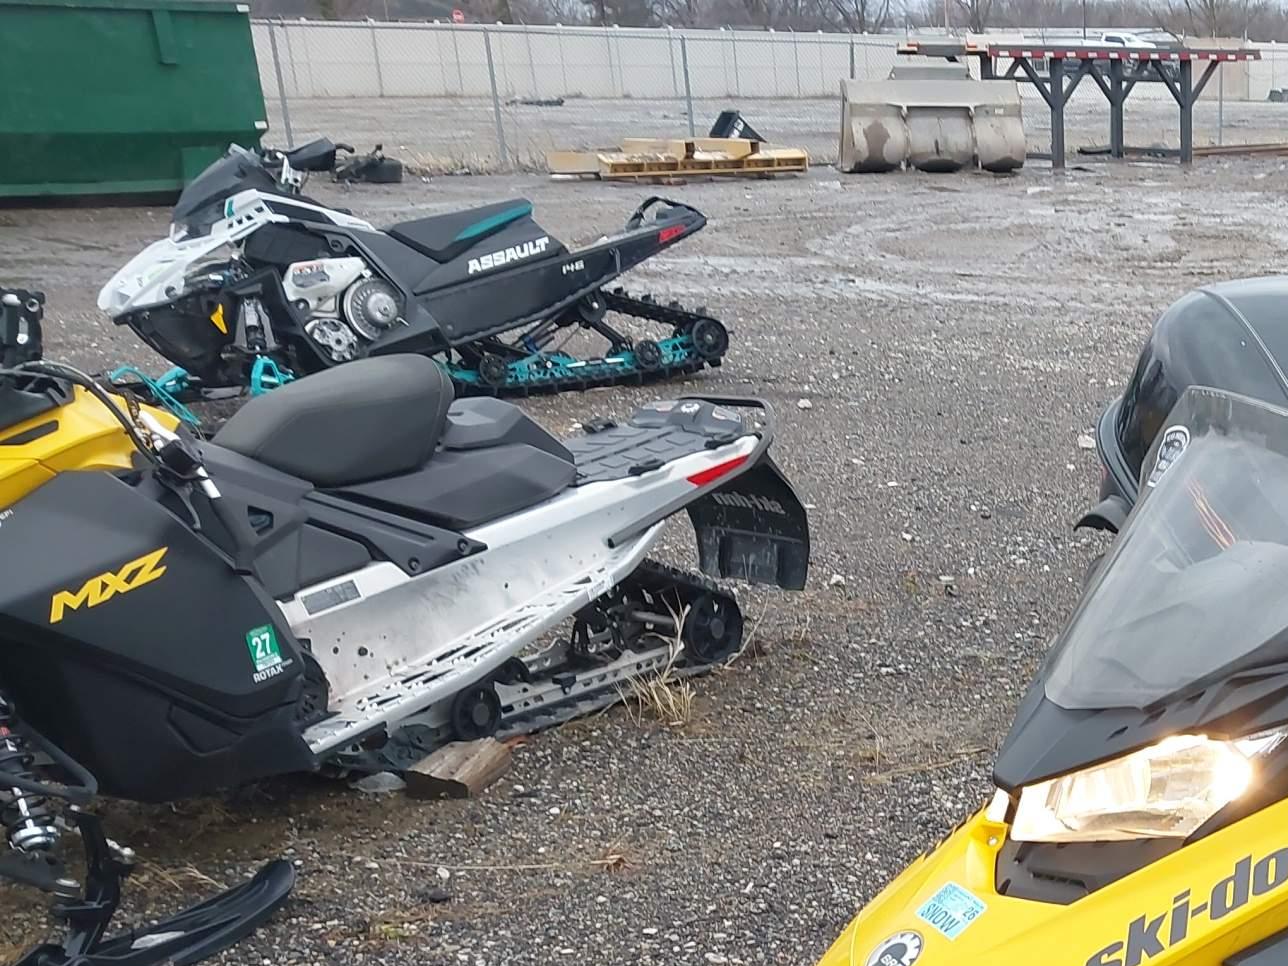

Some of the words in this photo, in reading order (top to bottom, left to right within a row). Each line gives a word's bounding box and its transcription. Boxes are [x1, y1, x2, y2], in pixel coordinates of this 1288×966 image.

[468, 237, 549, 274] ASSAULT
[50, 546, 169, 624] MXZ
[252, 631, 271, 659] 27
[253, 663, 284, 684] ROTAX
[920, 903, 961, 933] SNOW
